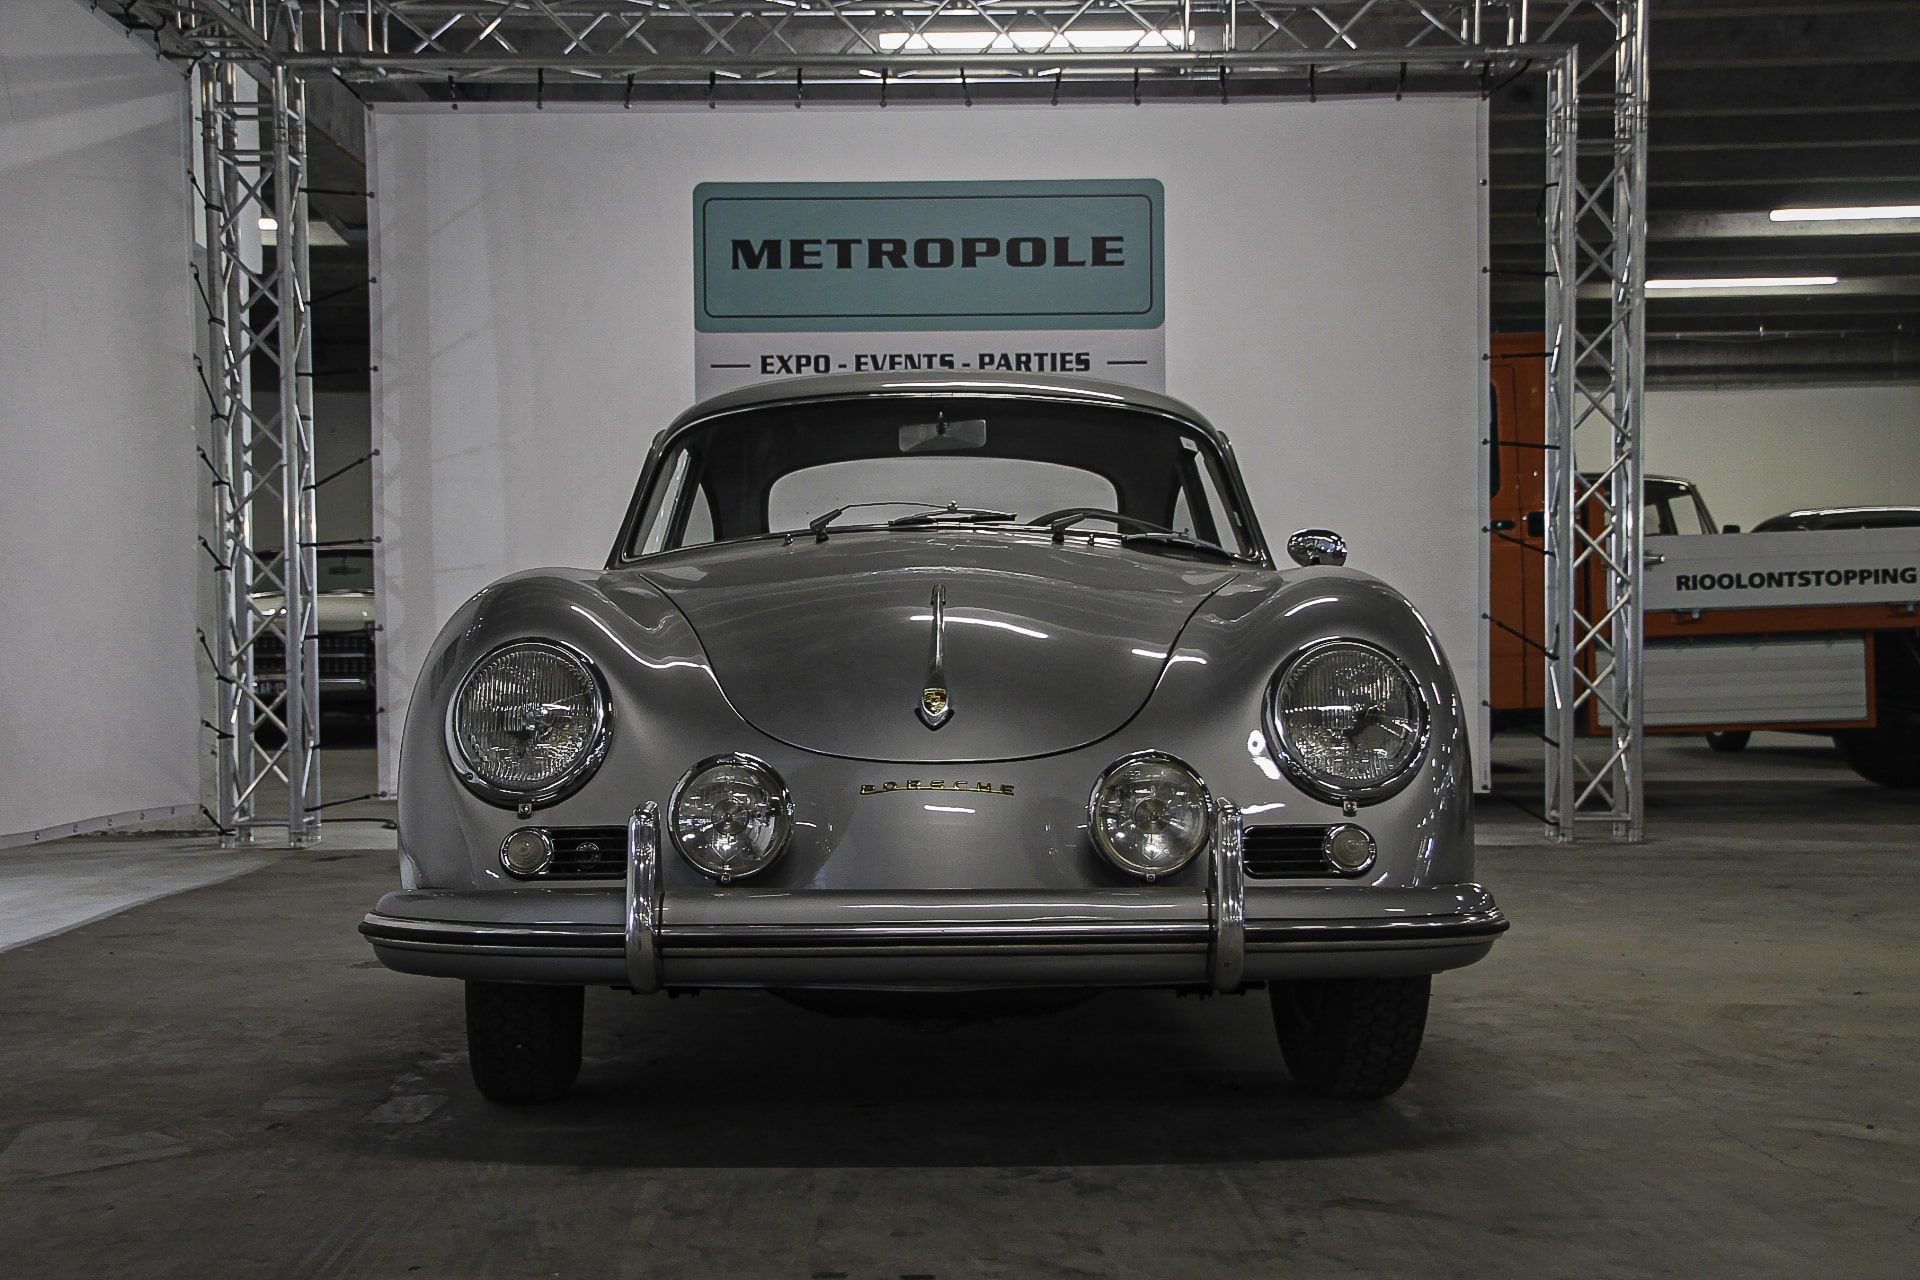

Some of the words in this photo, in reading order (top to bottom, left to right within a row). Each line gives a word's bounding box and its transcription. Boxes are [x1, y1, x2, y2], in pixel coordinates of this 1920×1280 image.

[731, 236, 1125, 270] METROPOLE
[760, 354, 831, 375] EXPO
[854, 353, 955, 372] EVENTS
[978, 352, 1091, 373] PARTIES
[1675, 566, 1918, 592] RIOOLONTSTOPPING
[860, 779, 1015, 796] PORSCHE
